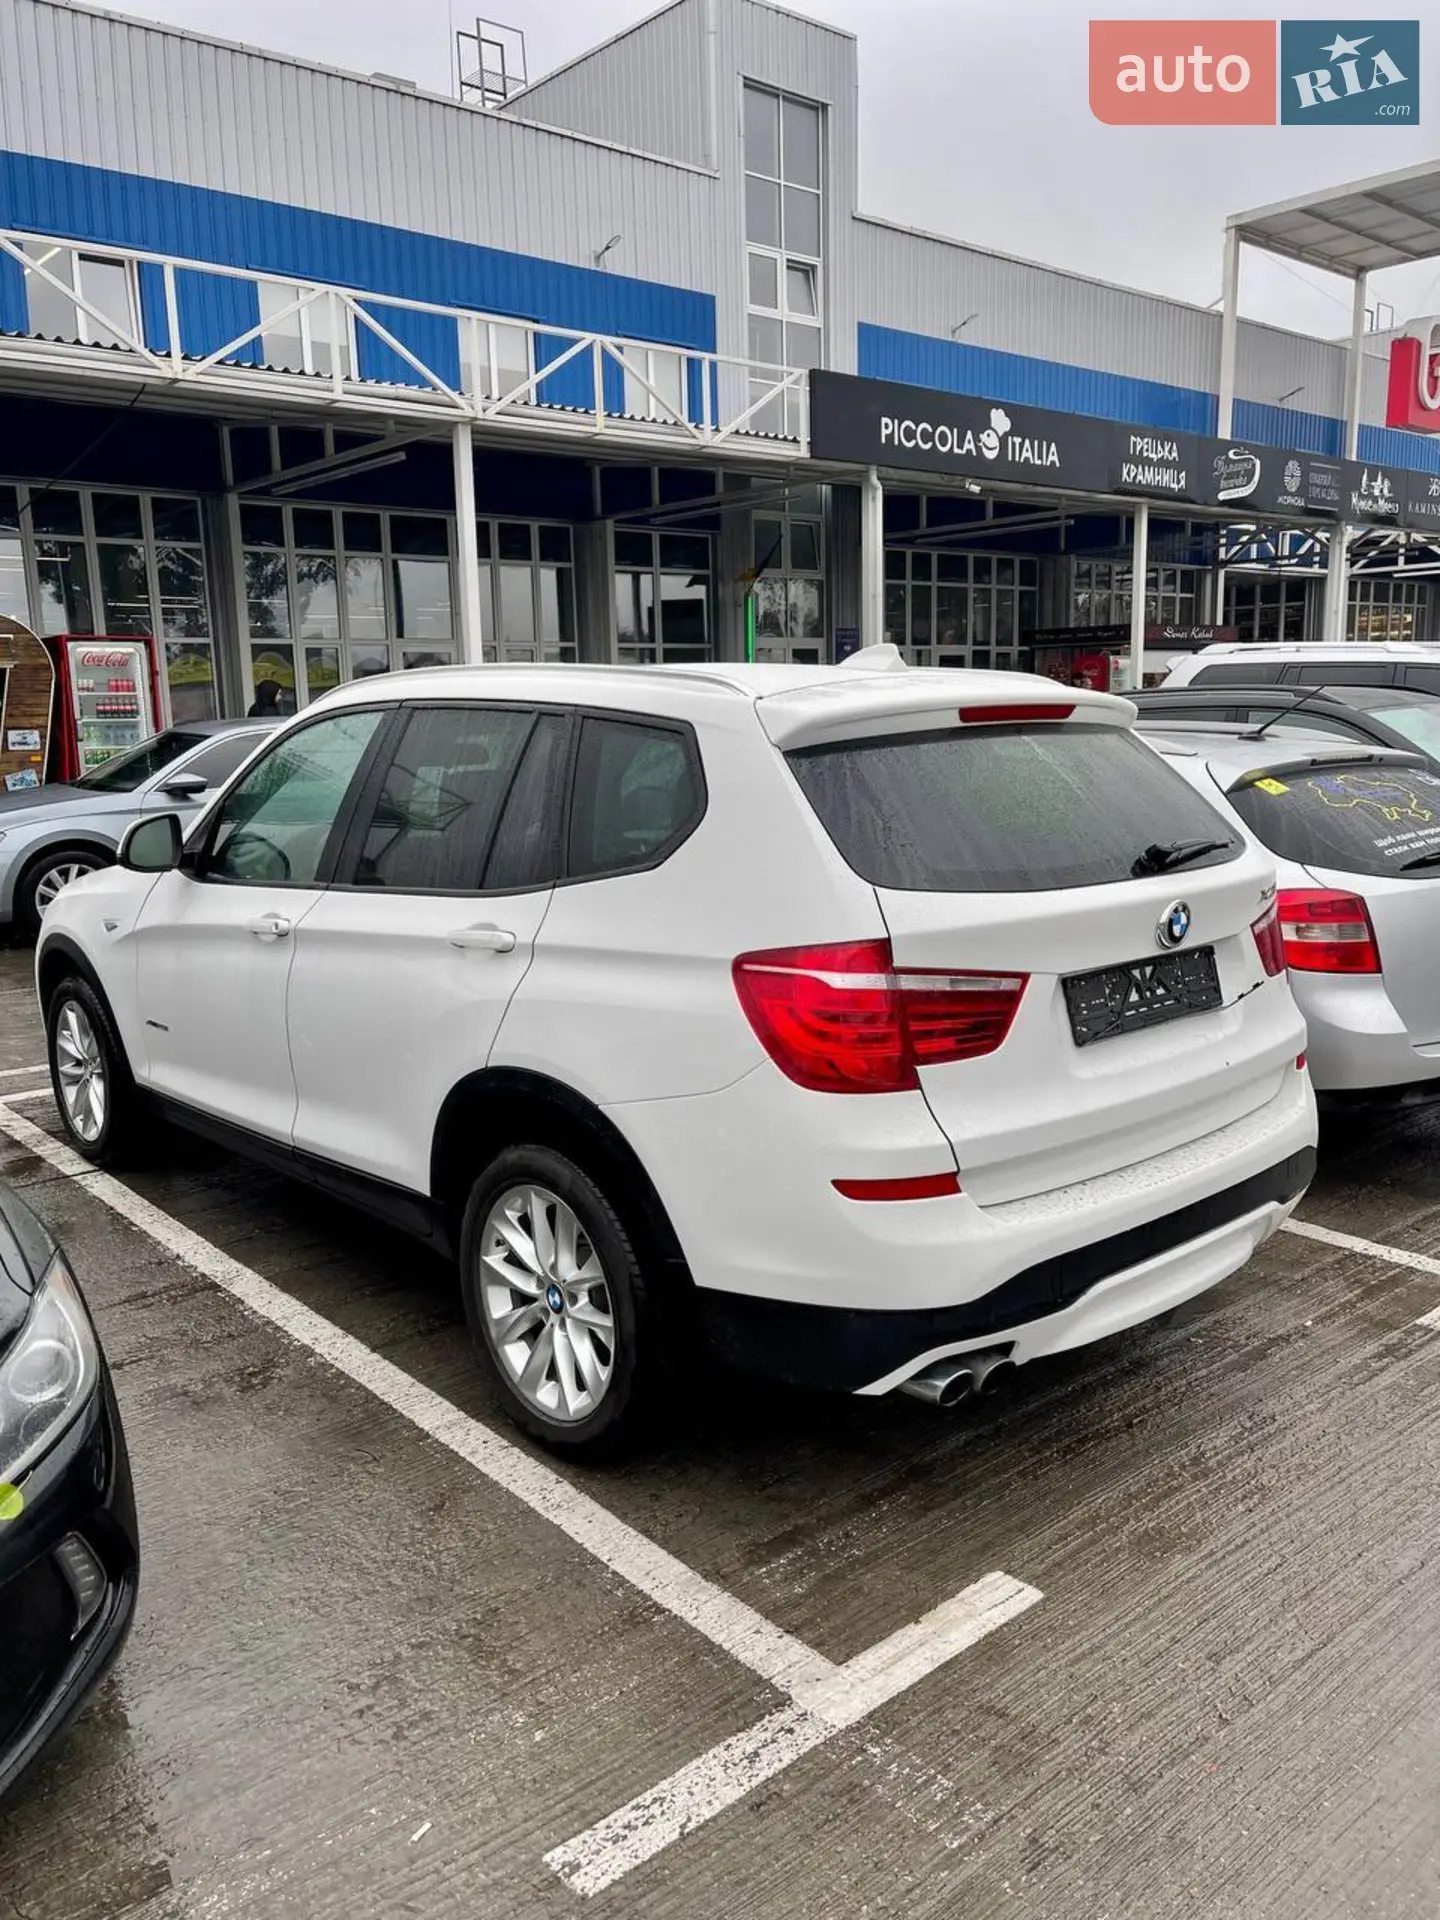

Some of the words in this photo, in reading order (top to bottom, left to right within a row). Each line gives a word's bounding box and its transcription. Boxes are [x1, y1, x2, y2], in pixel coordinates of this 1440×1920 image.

[881, 416, 977, 456] PICCOLA
[1007, 435, 1060, 468] ITALIA
[1129, 433, 1179, 462] ГРЕЦЬКА
[1121, 462, 1187, 491] КРАМНИЦЯ
